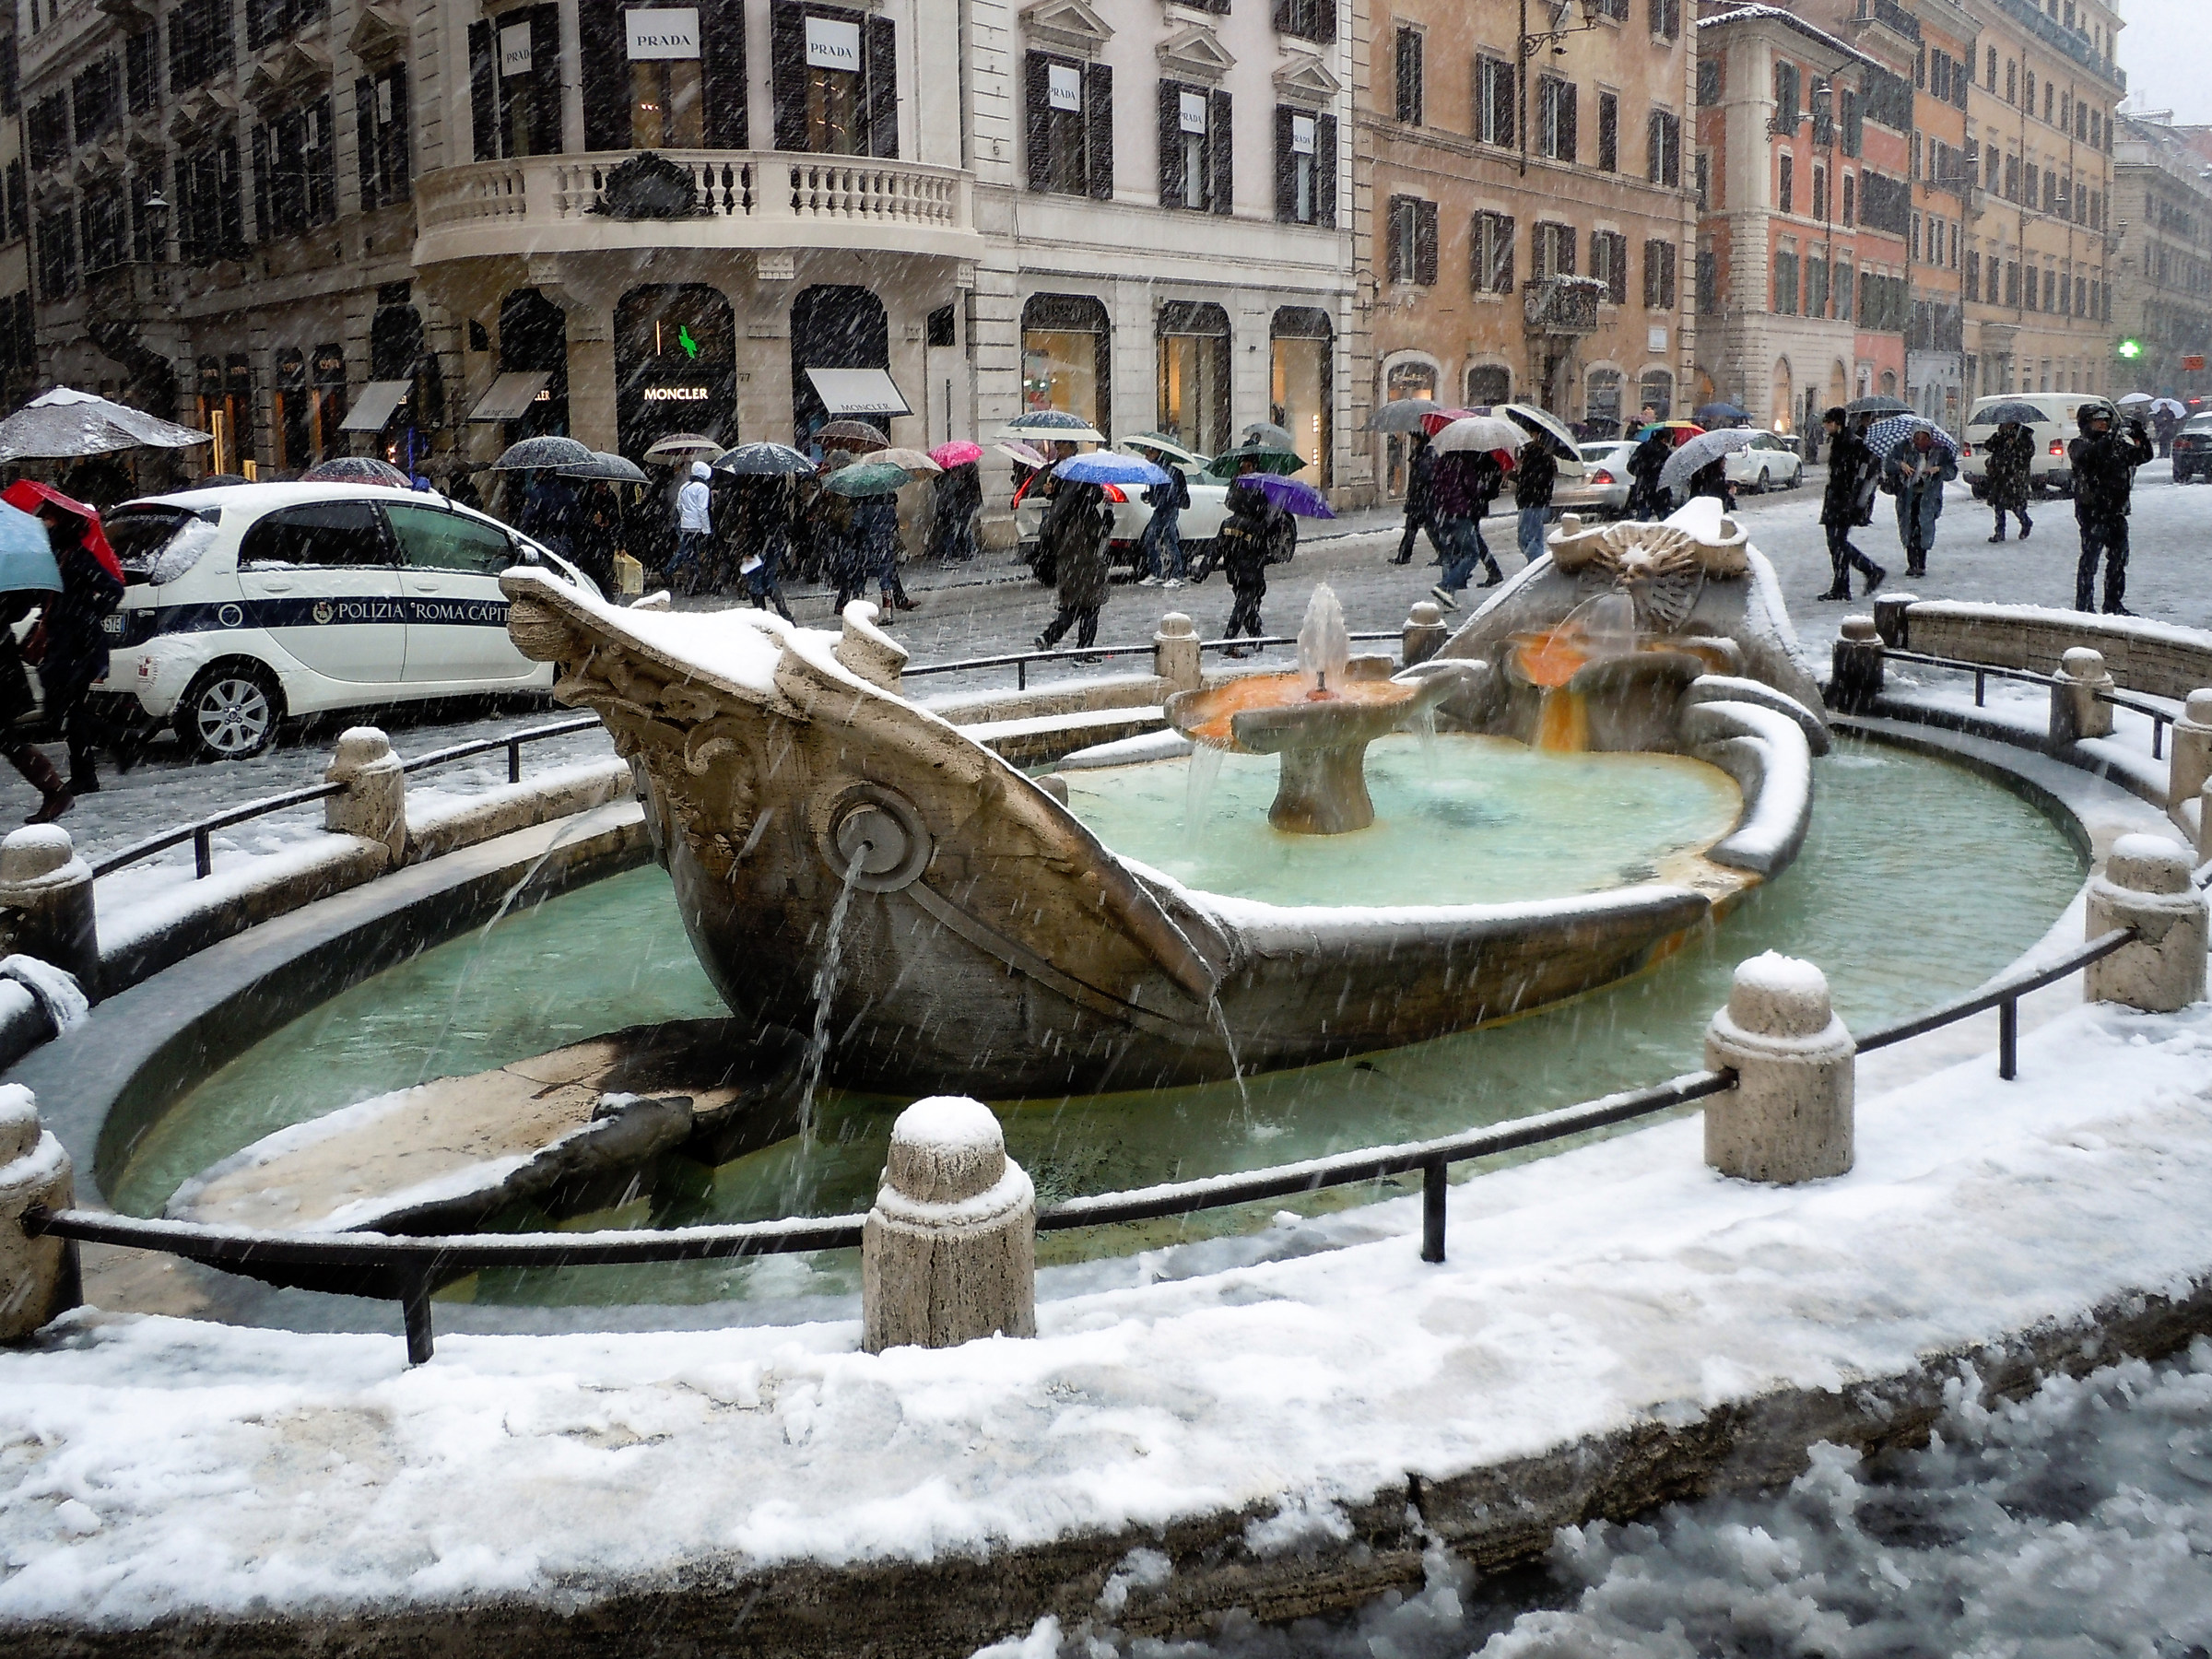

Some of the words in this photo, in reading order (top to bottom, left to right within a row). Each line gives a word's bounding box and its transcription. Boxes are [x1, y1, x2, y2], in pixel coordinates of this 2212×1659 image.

[637, 35, 692, 46] PRADA
[810, 42, 853, 58] PRADA
[644, 388, 709, 400] MONCLER
[841, 403, 891, 411] MONCLER
[338, 603, 405, 618] POLIZIA
[417, 604, 464, 619] ROMA
